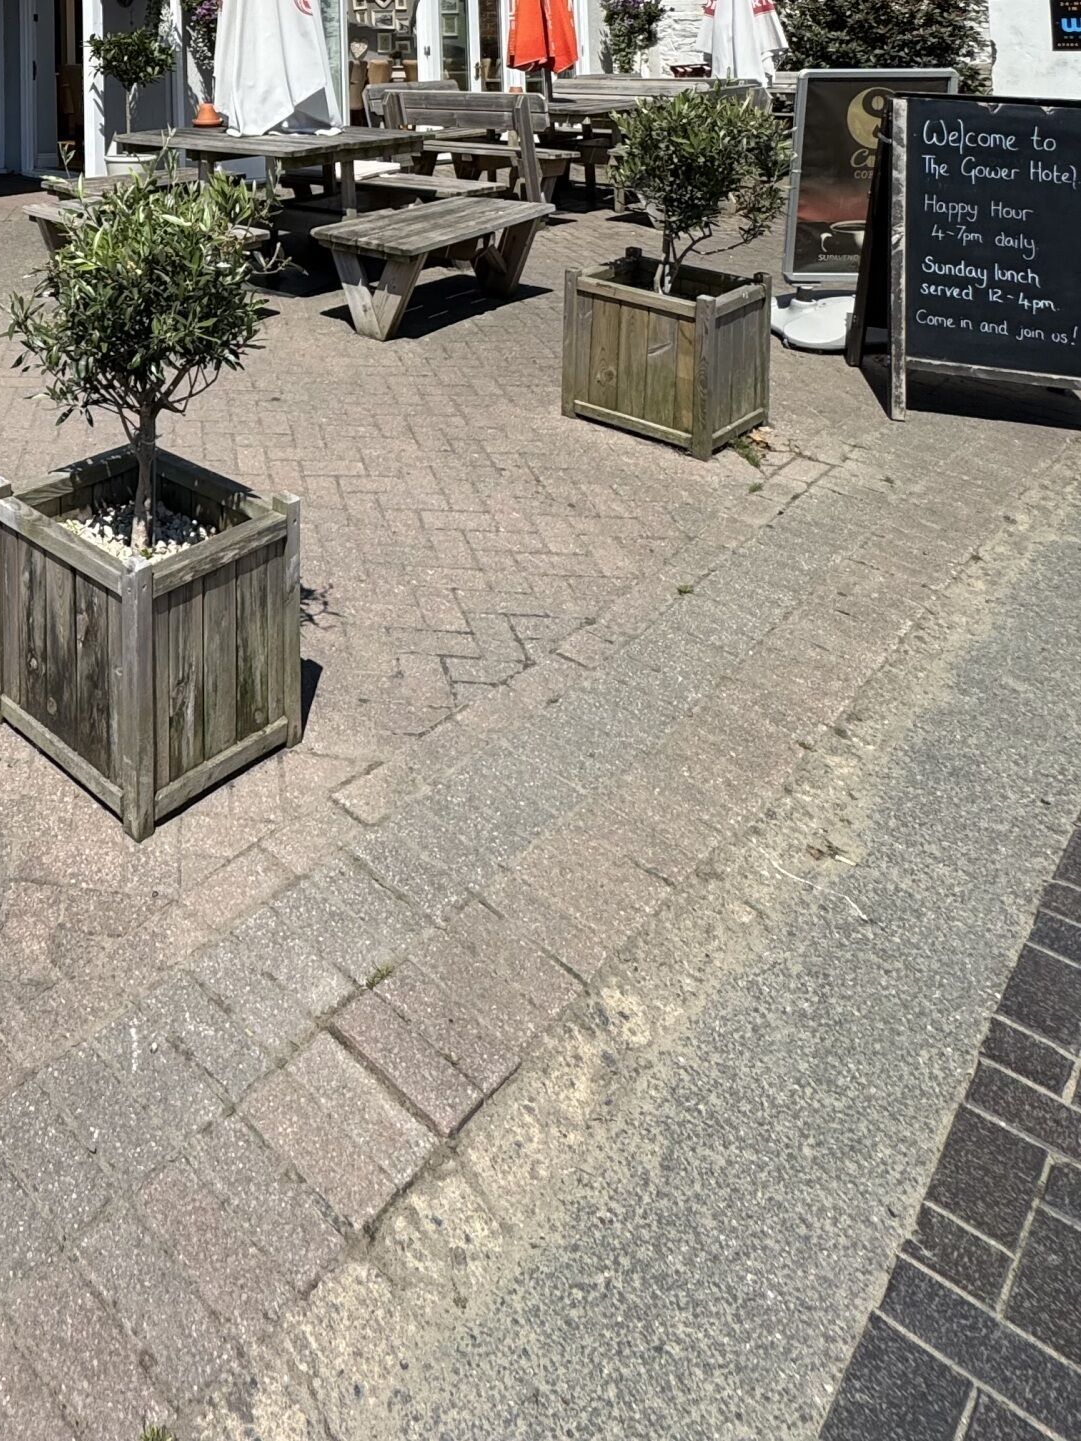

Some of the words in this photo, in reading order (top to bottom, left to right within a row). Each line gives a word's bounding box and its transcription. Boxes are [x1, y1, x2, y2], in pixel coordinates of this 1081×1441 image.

[923, 119, 1019, 154] Welcome
[1031, 126, 1056, 151] to
[921, 155, 950, 179] The
[961, 157, 1020, 184] Gower
[924, 194, 978, 222] Happy
[991, 200, 1034, 221] Hour
[922, 255, 987, 288] Sunday
[995, 263, 1041, 288] lunch
[920, 282, 973, 300] served
[916, 309, 956, 328] Come
[960, 318, 973, 330] in
[980, 321, 1009, 335] and
[1016, 326, 1044, 341] join
[1051, 326, 1078, 346] us!
